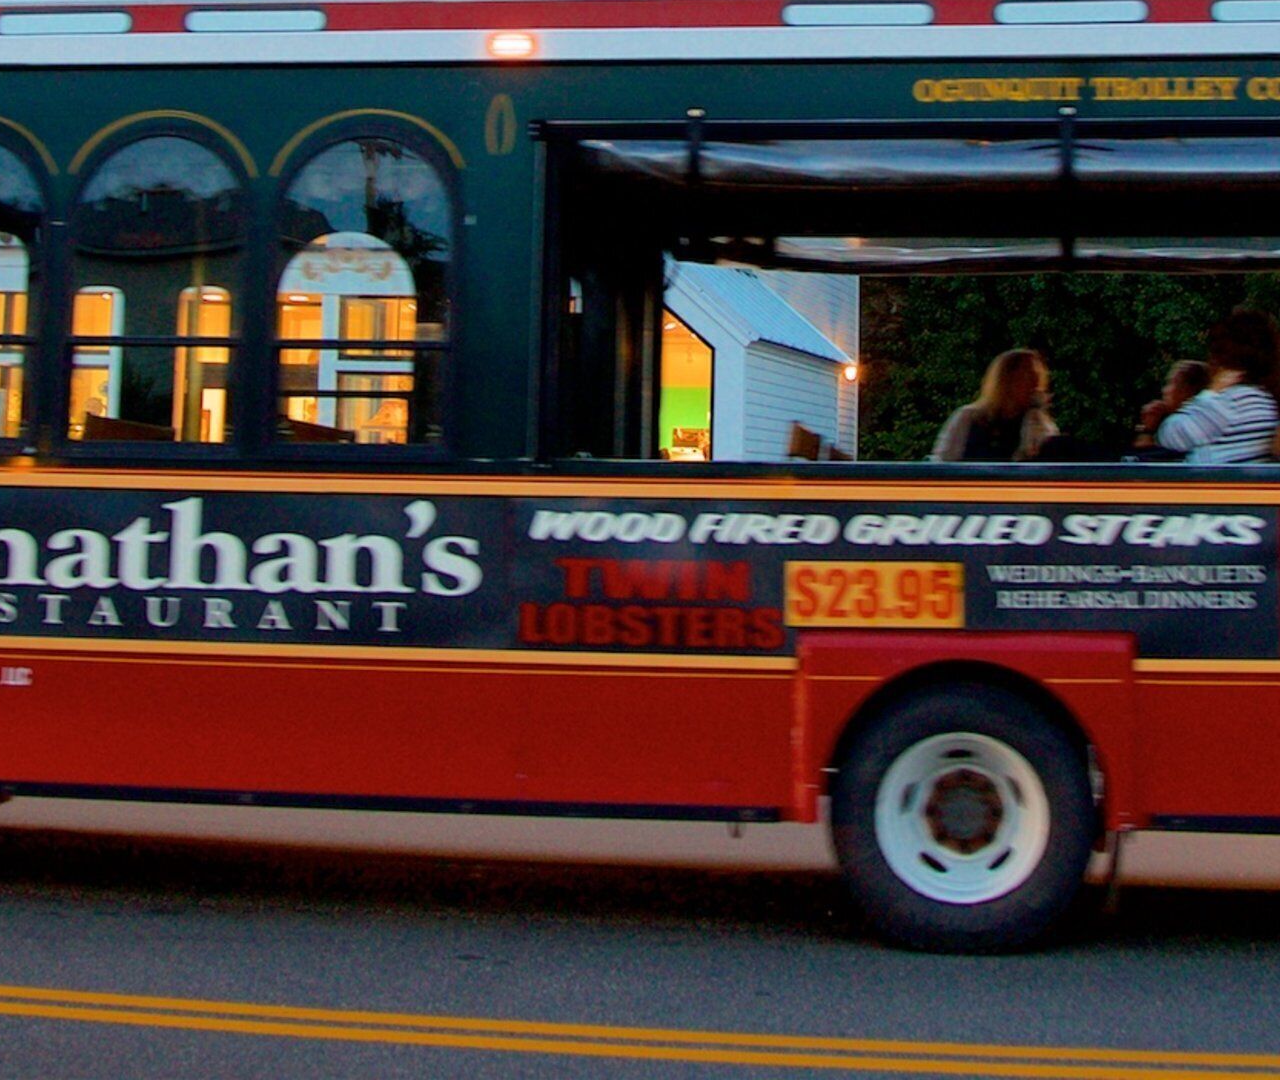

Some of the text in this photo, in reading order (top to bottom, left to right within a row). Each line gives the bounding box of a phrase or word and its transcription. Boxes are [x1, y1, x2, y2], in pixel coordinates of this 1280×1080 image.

[1090, 77, 1241, 101] TROLLEY
[528, 510, 1267, 548] WOOD FIRED GRILLED STEAKS
[554, 557, 752, 602] TWIN
[793, 567, 956, 620] $23.95
[996, 590, 1258, 609] REHEARSAL DINNERS
[517, 602, 786, 649] LOBSTERS
